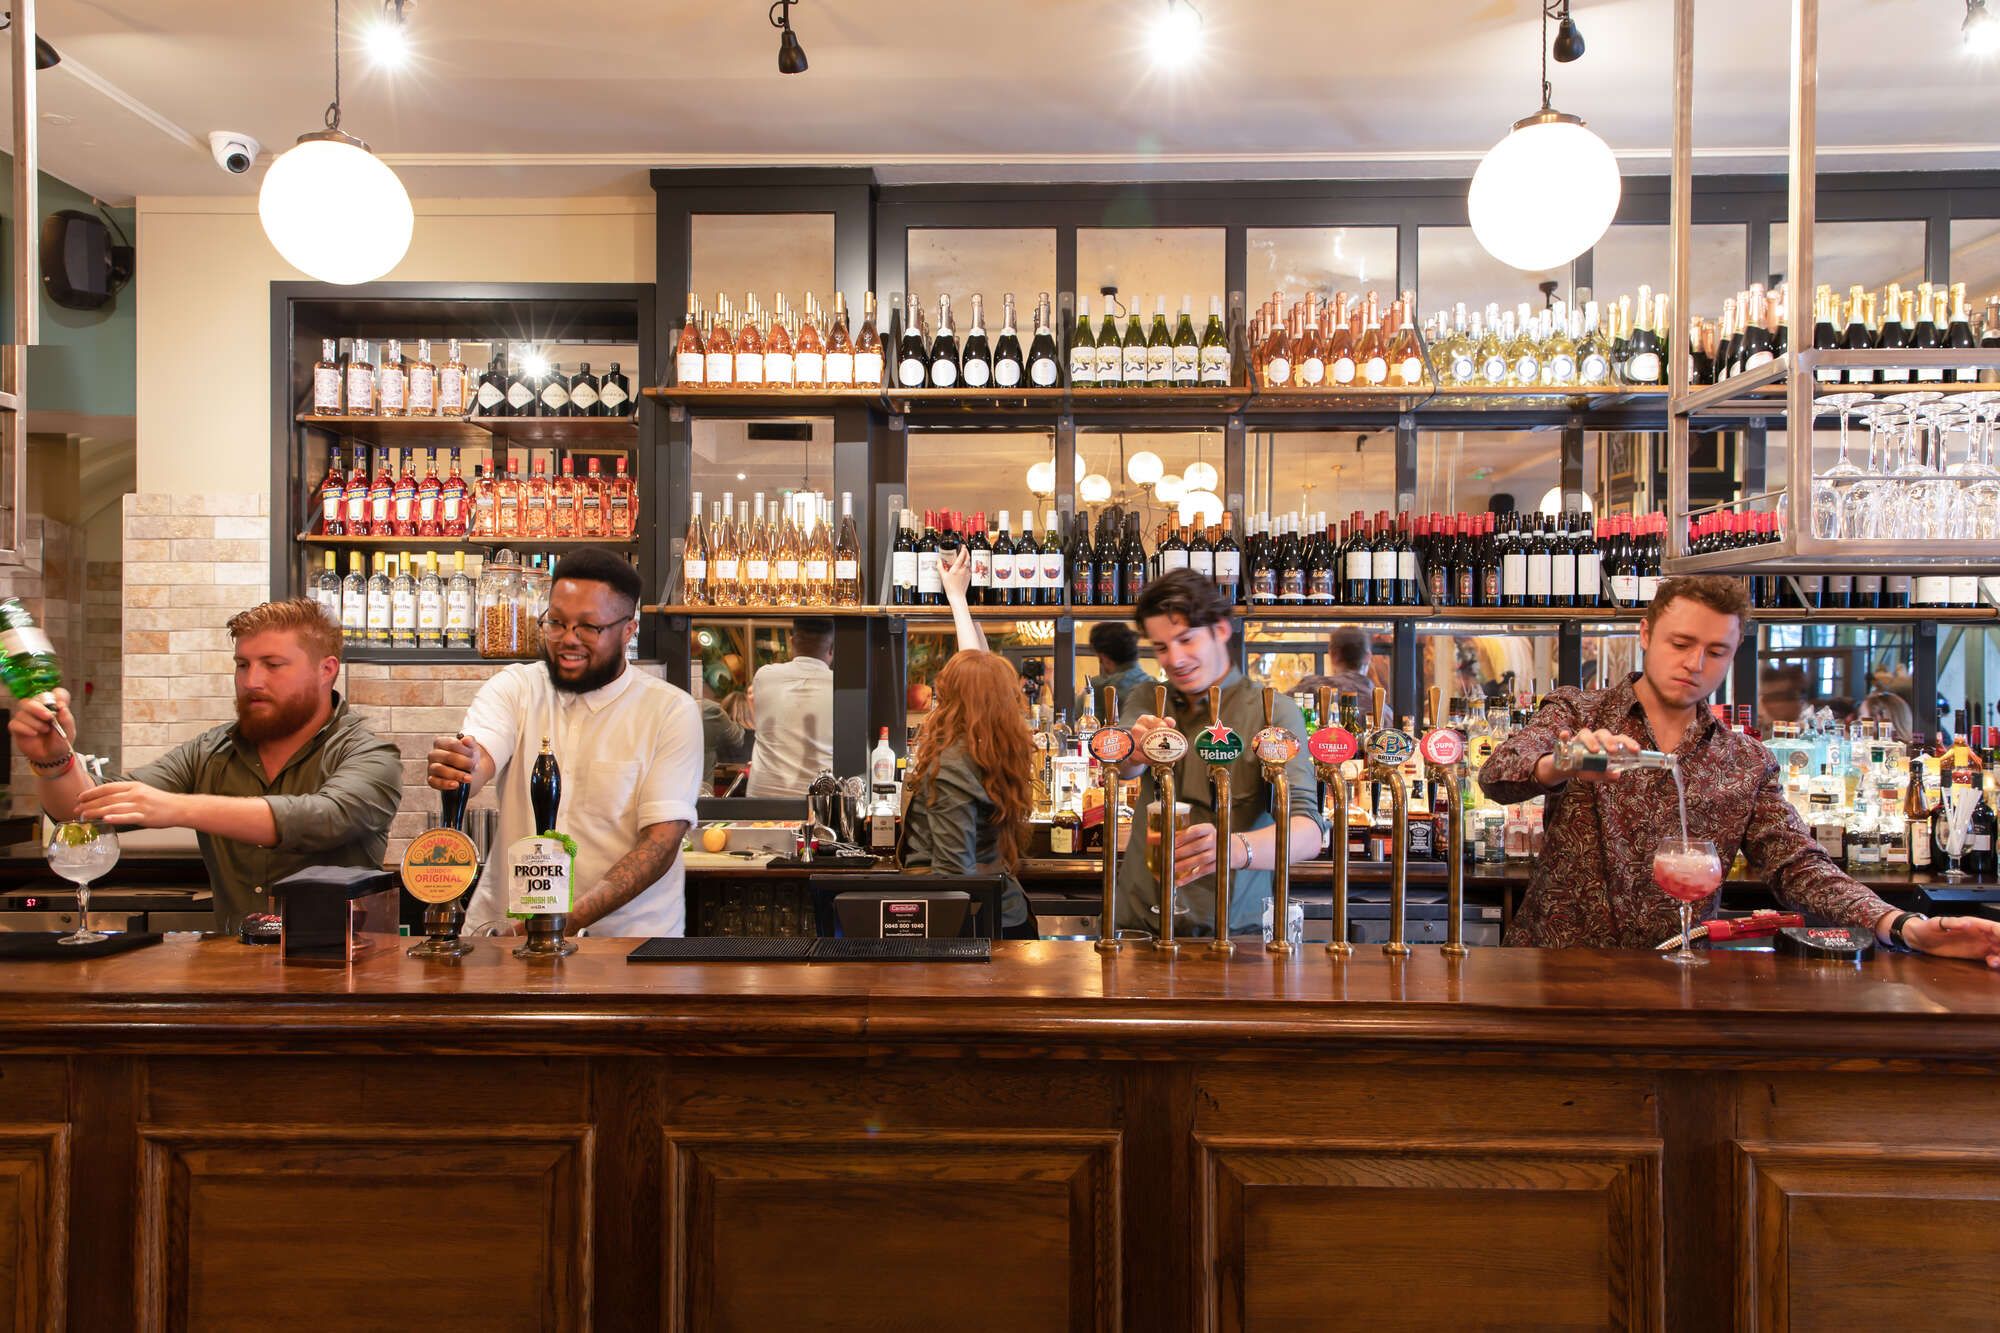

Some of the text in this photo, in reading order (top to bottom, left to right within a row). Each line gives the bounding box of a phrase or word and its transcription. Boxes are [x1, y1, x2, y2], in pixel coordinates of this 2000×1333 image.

[515, 865, 563, 877] PROPER
[415, 874, 463, 883] ORIGINAL
[527, 879, 551, 893] JOB
[547, 896, 557, 904] IPA
